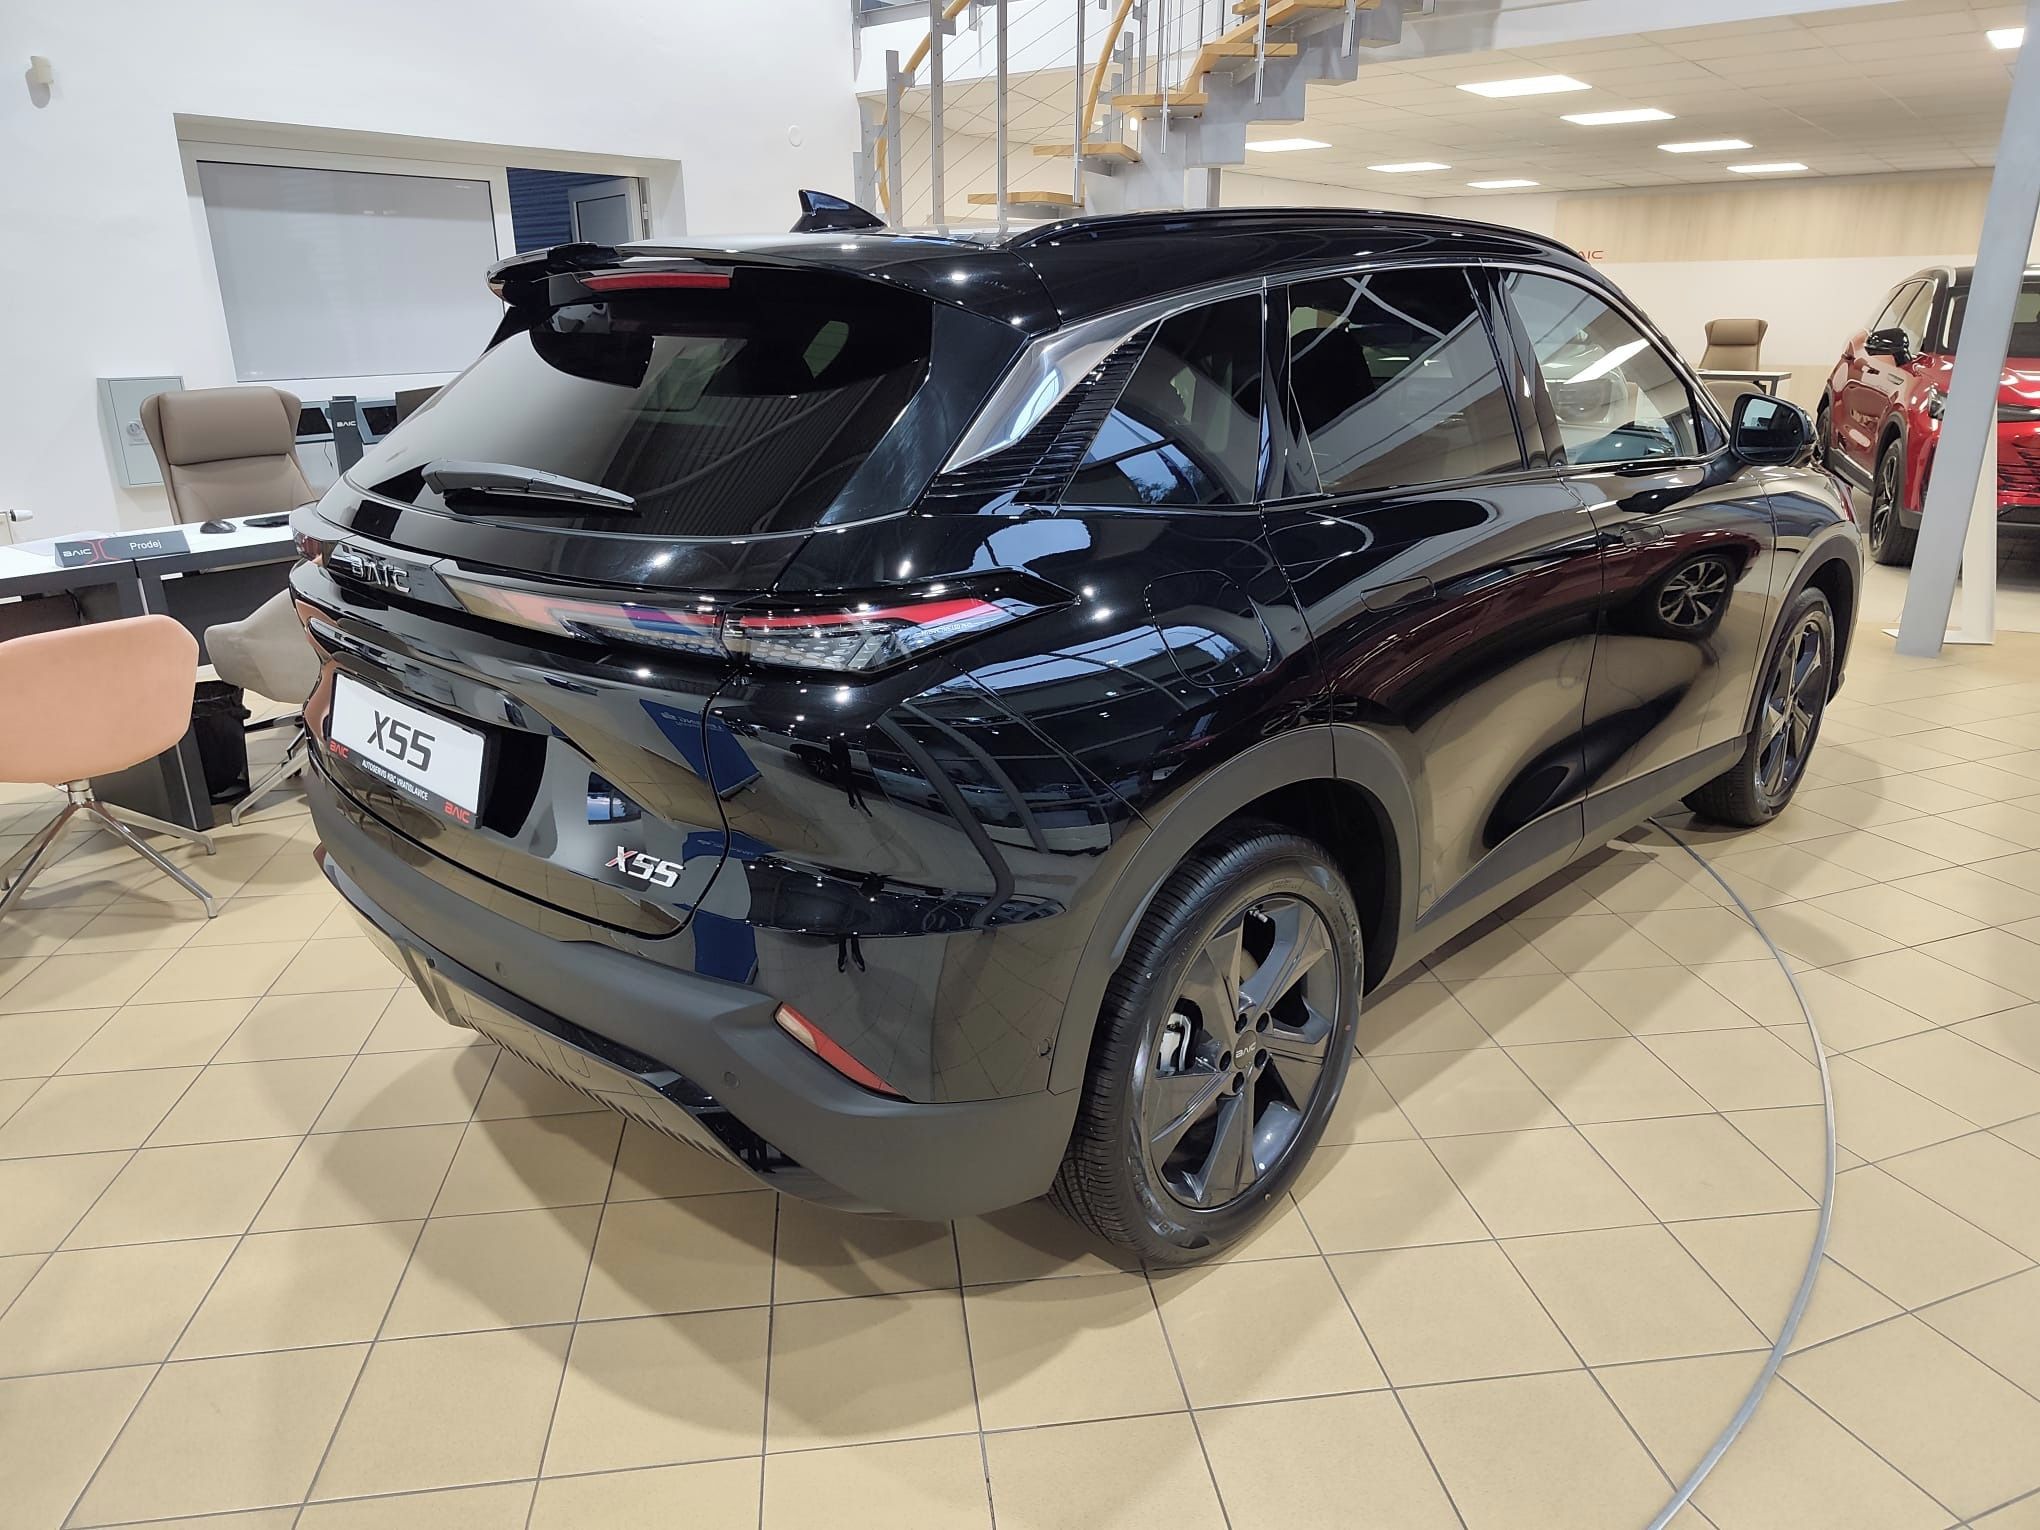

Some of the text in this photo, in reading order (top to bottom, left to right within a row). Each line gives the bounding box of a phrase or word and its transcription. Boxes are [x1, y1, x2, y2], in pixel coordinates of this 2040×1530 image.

[336, 420, 357, 428] BAIC
[62, 540, 162, 557] BAIC Prodej
[329, 740, 350, 759] BAIC
[367, 709, 436, 772] X55
[444, 801, 472, 824] BAIC
[604, 845, 685, 888] X55
[1235, 1041, 1257, 1059] BAIC
